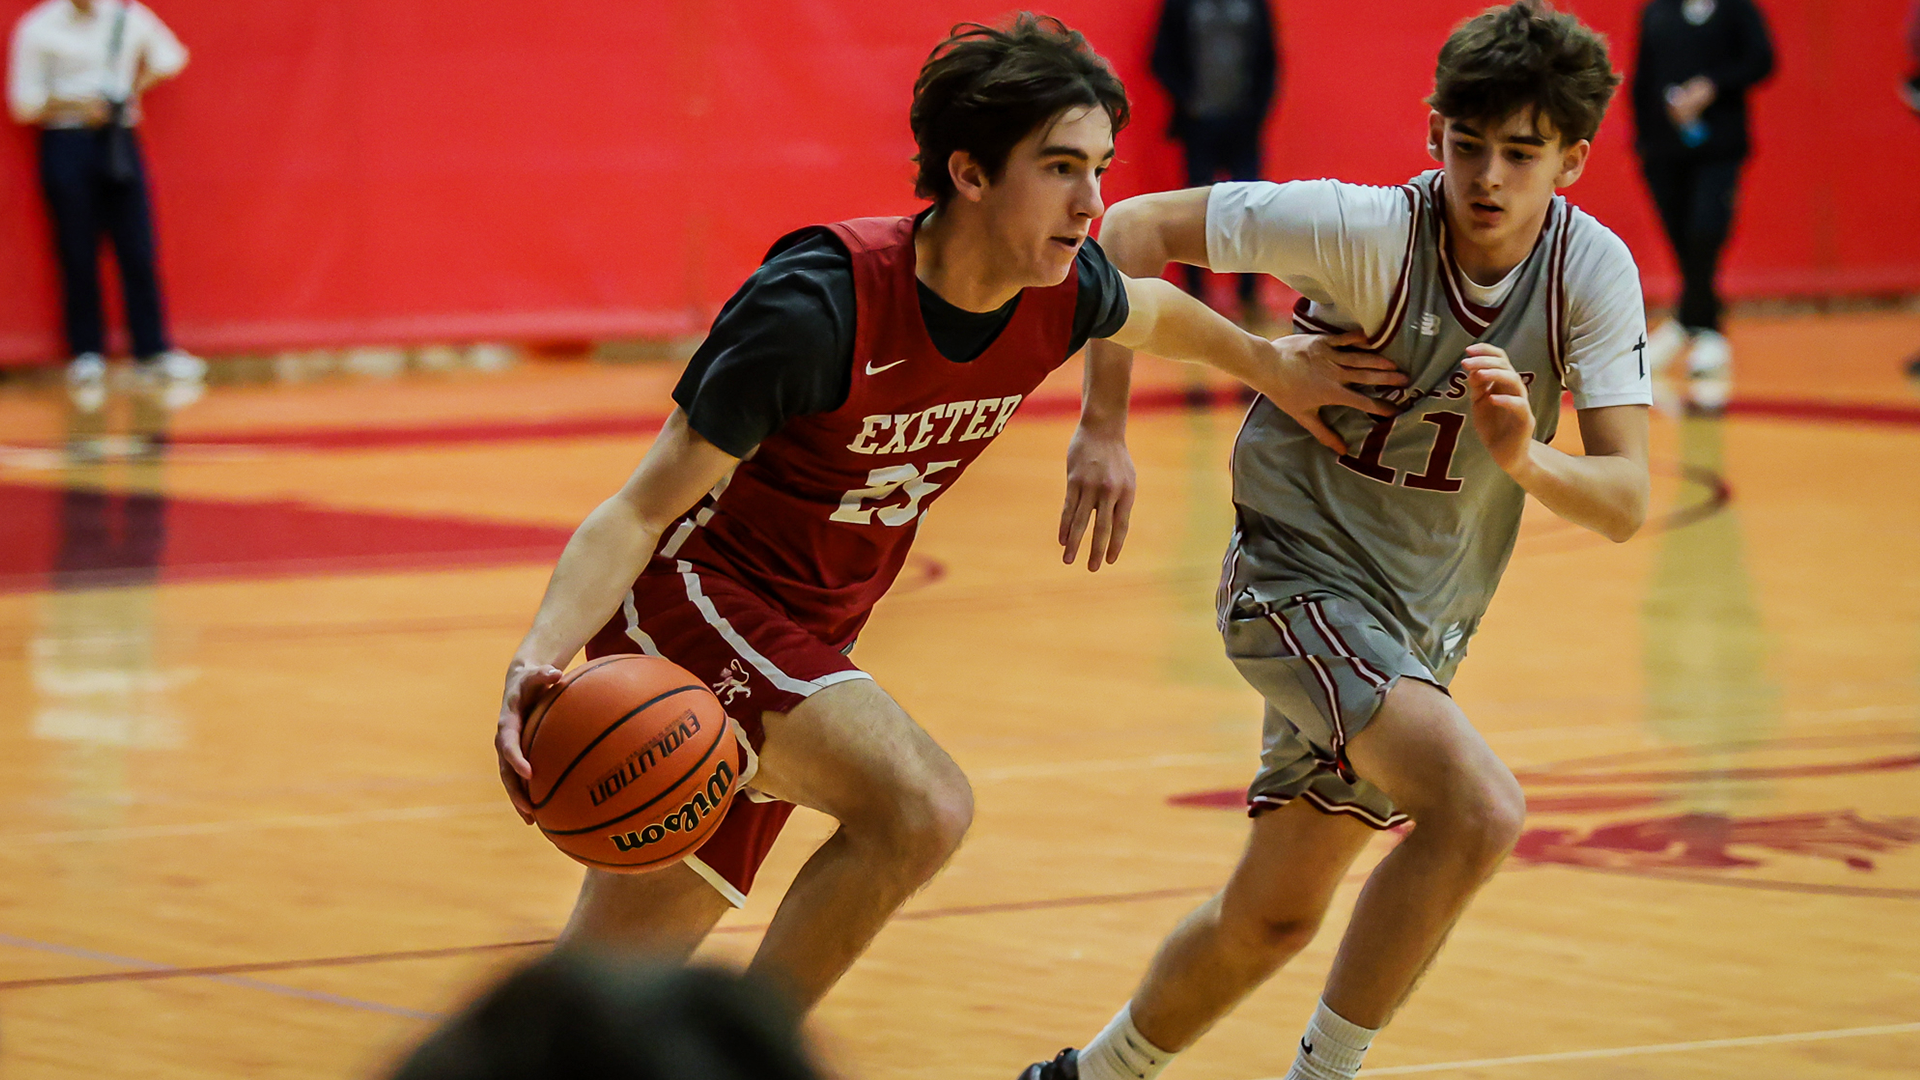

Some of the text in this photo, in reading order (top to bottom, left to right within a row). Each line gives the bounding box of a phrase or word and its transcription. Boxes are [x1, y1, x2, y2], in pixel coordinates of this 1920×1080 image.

[846, 394, 1023, 455] EXETER
[1336, 410, 1467, 493] 11
[829, 459, 962, 527] 25
[589, 714, 702, 807] EVOLUTION
[609, 759, 735, 853] Wilson
